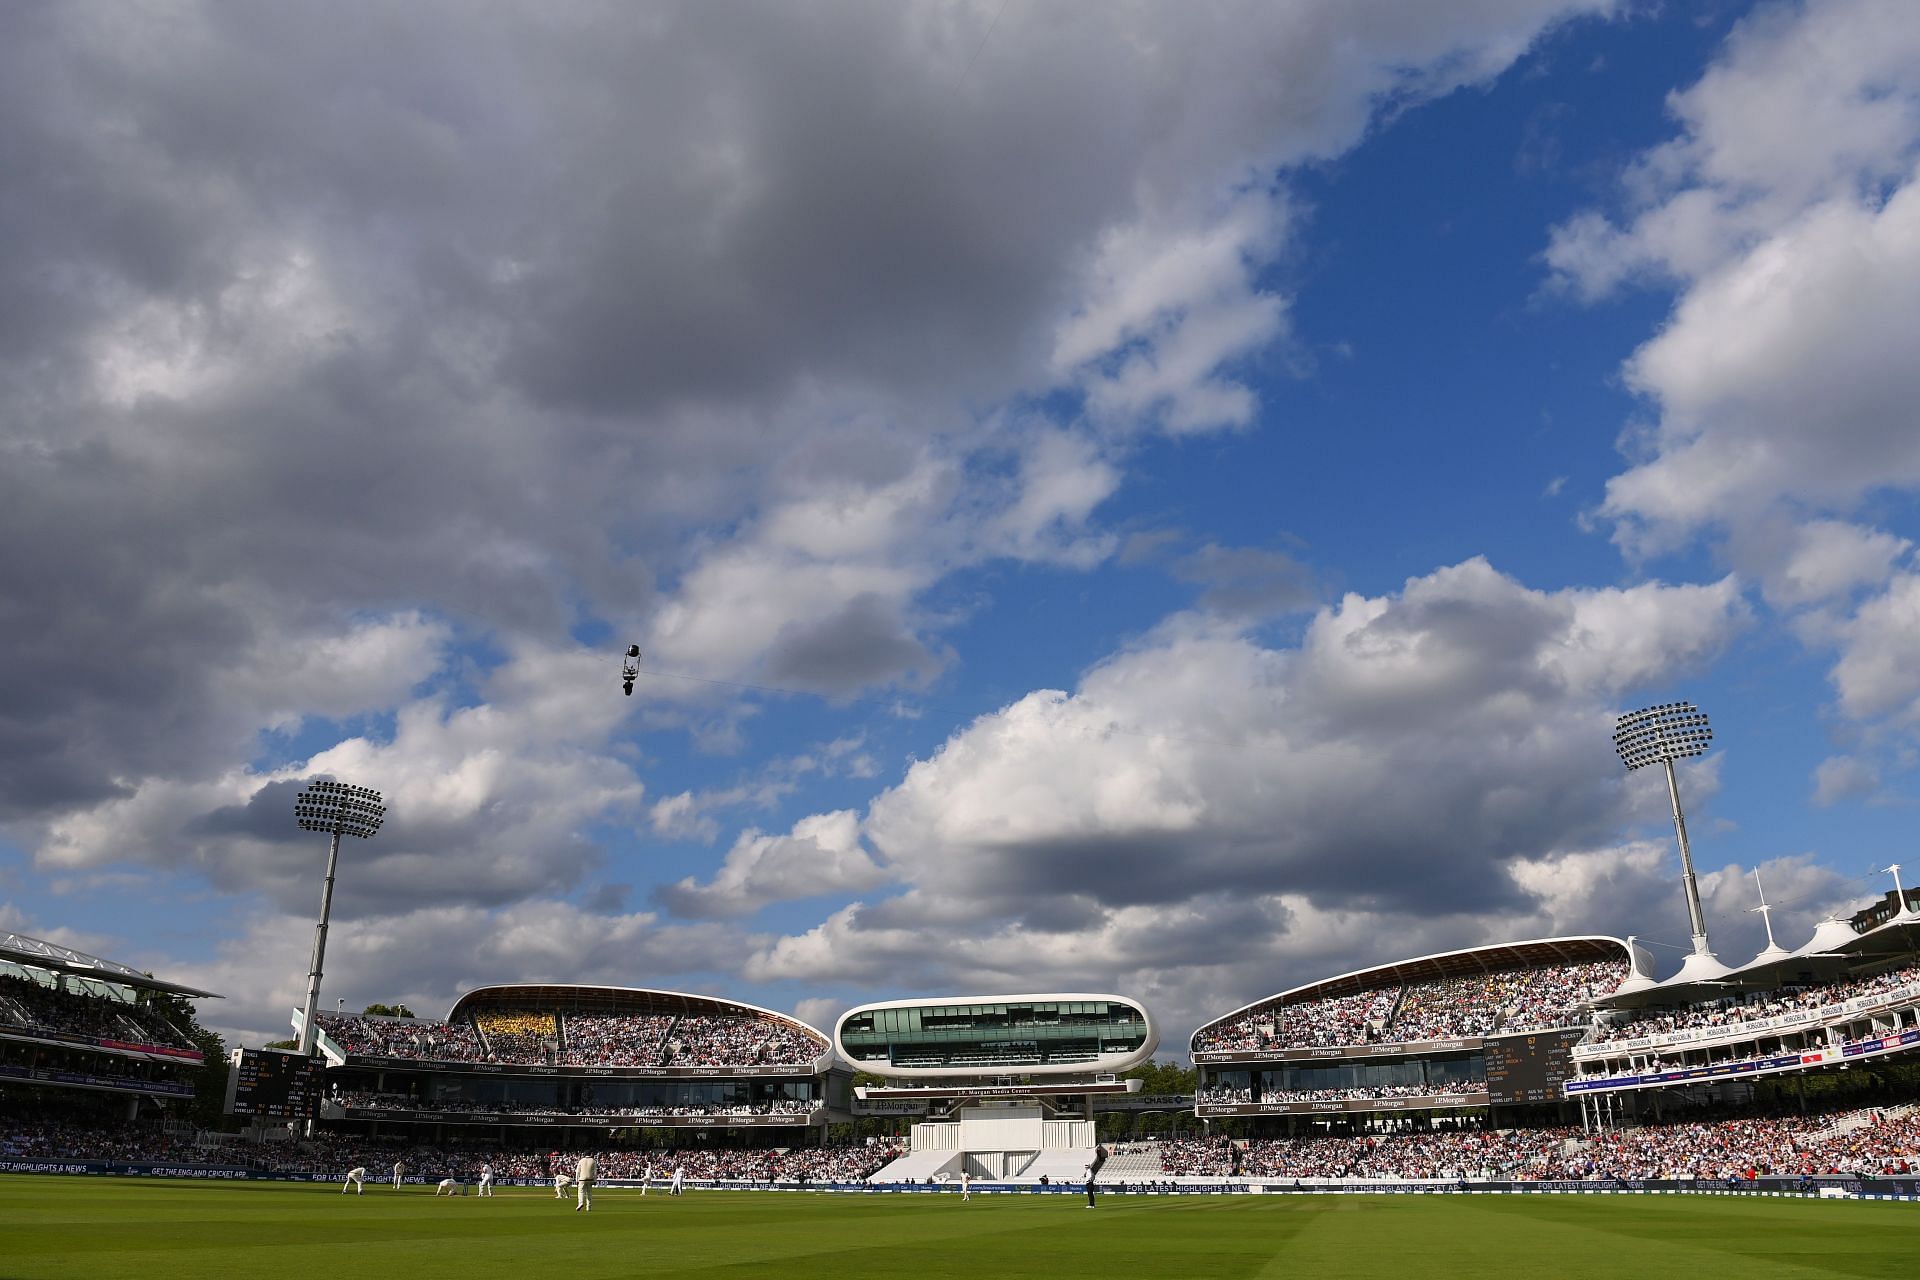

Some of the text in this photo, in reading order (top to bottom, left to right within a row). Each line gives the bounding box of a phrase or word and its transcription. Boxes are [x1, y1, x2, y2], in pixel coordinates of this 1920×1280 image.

[1706, 1027, 1731, 1037] HOBGOBLIN
[1746, 1022, 1769, 1030] HOBGOBLIN
[1784, 1014, 1808, 1024] HOBGOBLIN
[1821, 1007, 1844, 1017] HOBGOBLIN
[1857, 998, 1878, 1010] HOBGOBLIN
[1890, 988, 1912, 1001] HOBGOBLIN
[13, 1162, 57, 1172] HIGHLIGHTS
[66, 1164, 87, 1172] NEWS
[1847, 1182, 1862, 1191] NEWS
